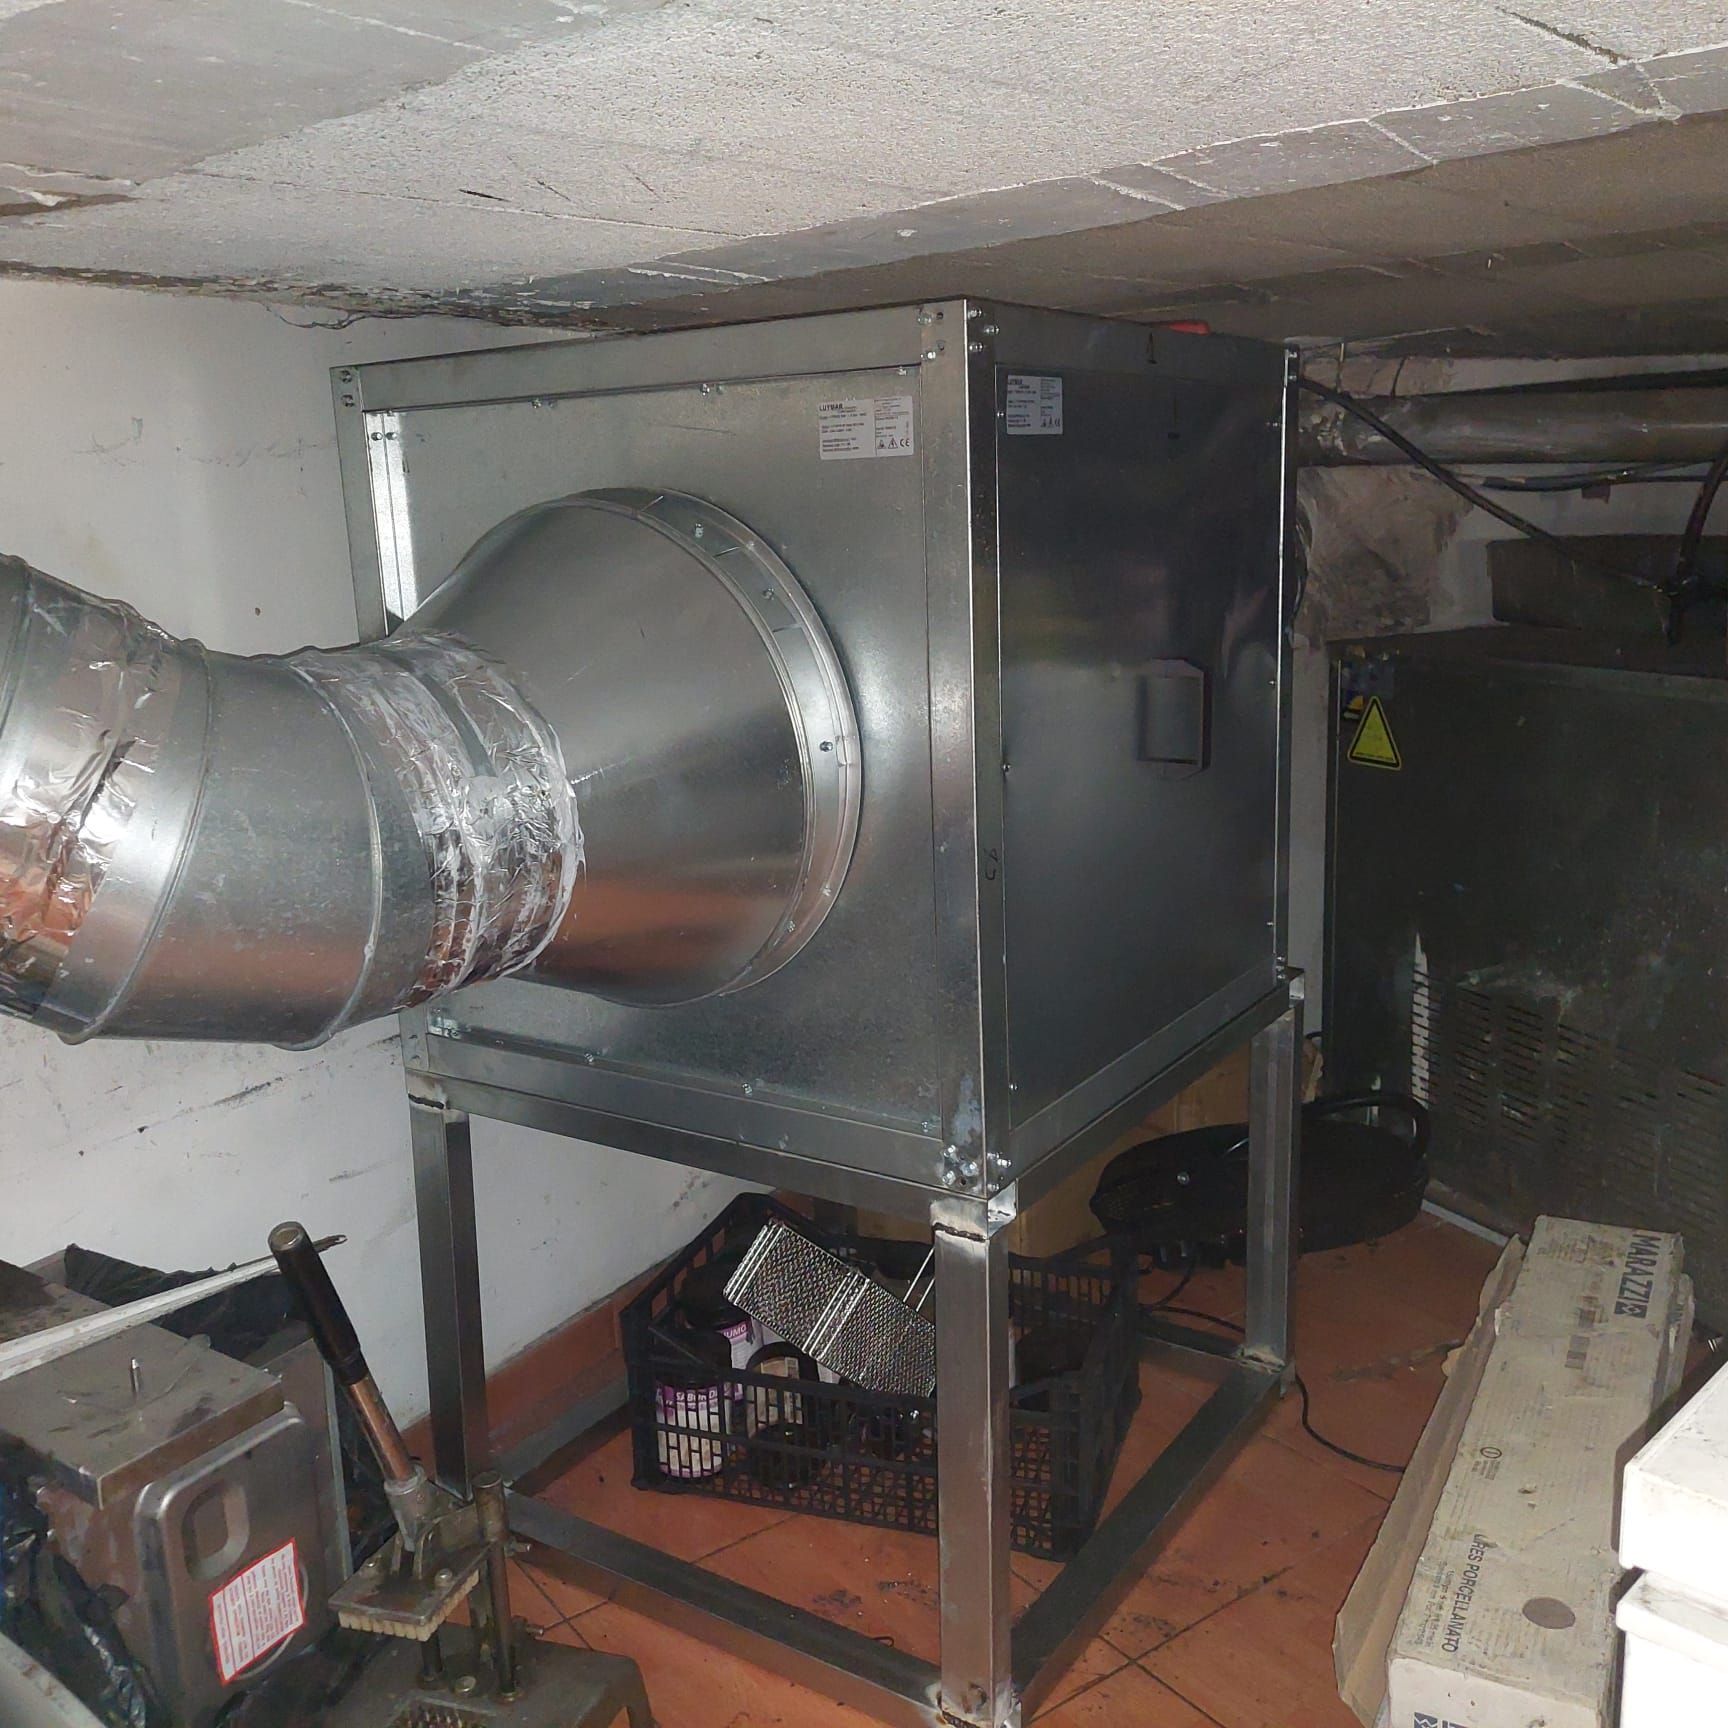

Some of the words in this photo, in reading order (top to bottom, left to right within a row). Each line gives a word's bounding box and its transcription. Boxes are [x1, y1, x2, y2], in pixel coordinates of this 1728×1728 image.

[1617, 1233, 1662, 1303] MARAZZI
[723, 1323, 747, 1338] UMO
[1441, 1563, 1480, 1652] PORCELLANATO
